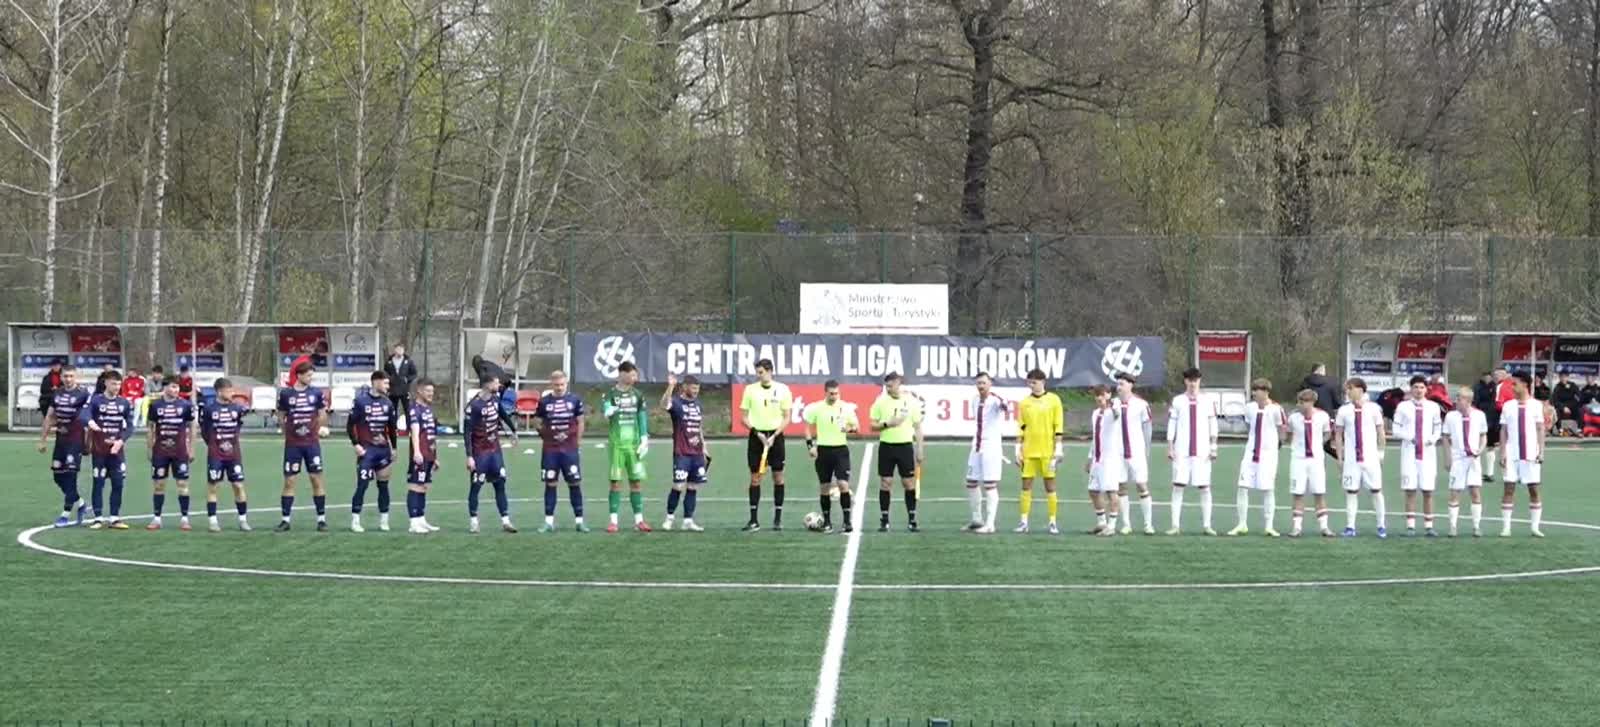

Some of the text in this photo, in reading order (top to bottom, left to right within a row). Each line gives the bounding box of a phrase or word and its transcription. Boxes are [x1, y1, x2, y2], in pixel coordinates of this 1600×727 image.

[848, 307, 883, 319] Sportu
[667, 340, 1066, 379] CENTRALNA LIGA JUNIORÓW
[937, 400, 951, 421] 3
